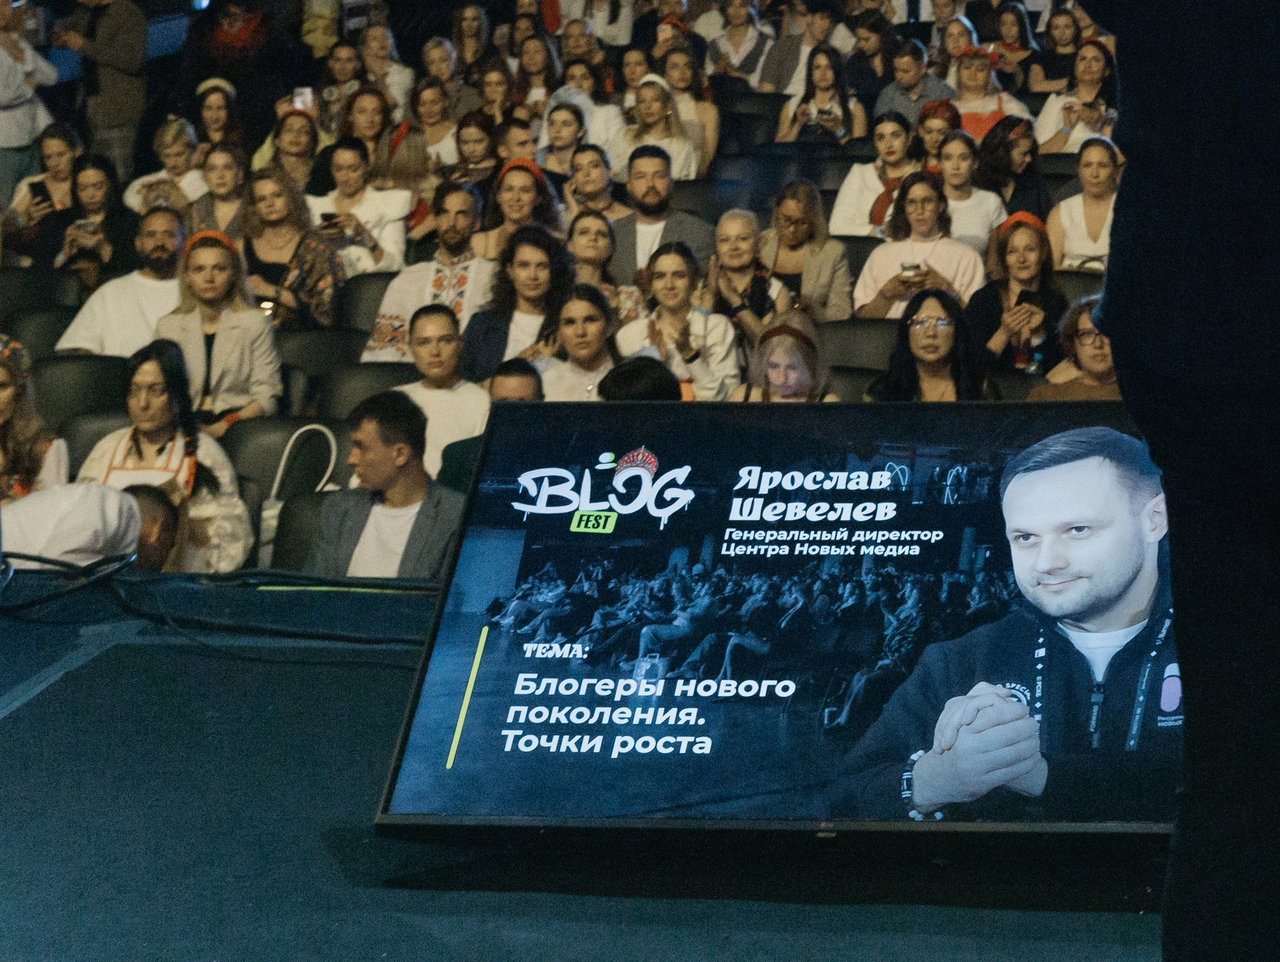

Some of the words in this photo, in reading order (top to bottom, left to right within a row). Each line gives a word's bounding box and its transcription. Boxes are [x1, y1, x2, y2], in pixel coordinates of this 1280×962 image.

[733, 465, 893, 495] Ярослав
[511, 464, 696, 529] BLOG
[576, 513, 611, 530] FEST
[729, 498, 897, 523] Шевелев
[724, 527, 849, 543] Генеральный
[852, 529, 944, 545] директор
[721, 542, 790, 558] Центра
[794, 542, 855, 556] Новых
[858, 544, 921, 557] медиа
[523, 642, 589, 659] ТЕМА:
[513, 672, 665, 701] Блогеры
[674, 678, 796, 698] нового
[506, 705, 706, 725] поколения.
[501, 729, 604, 753] Точки
[611, 734, 713, 758] роста
